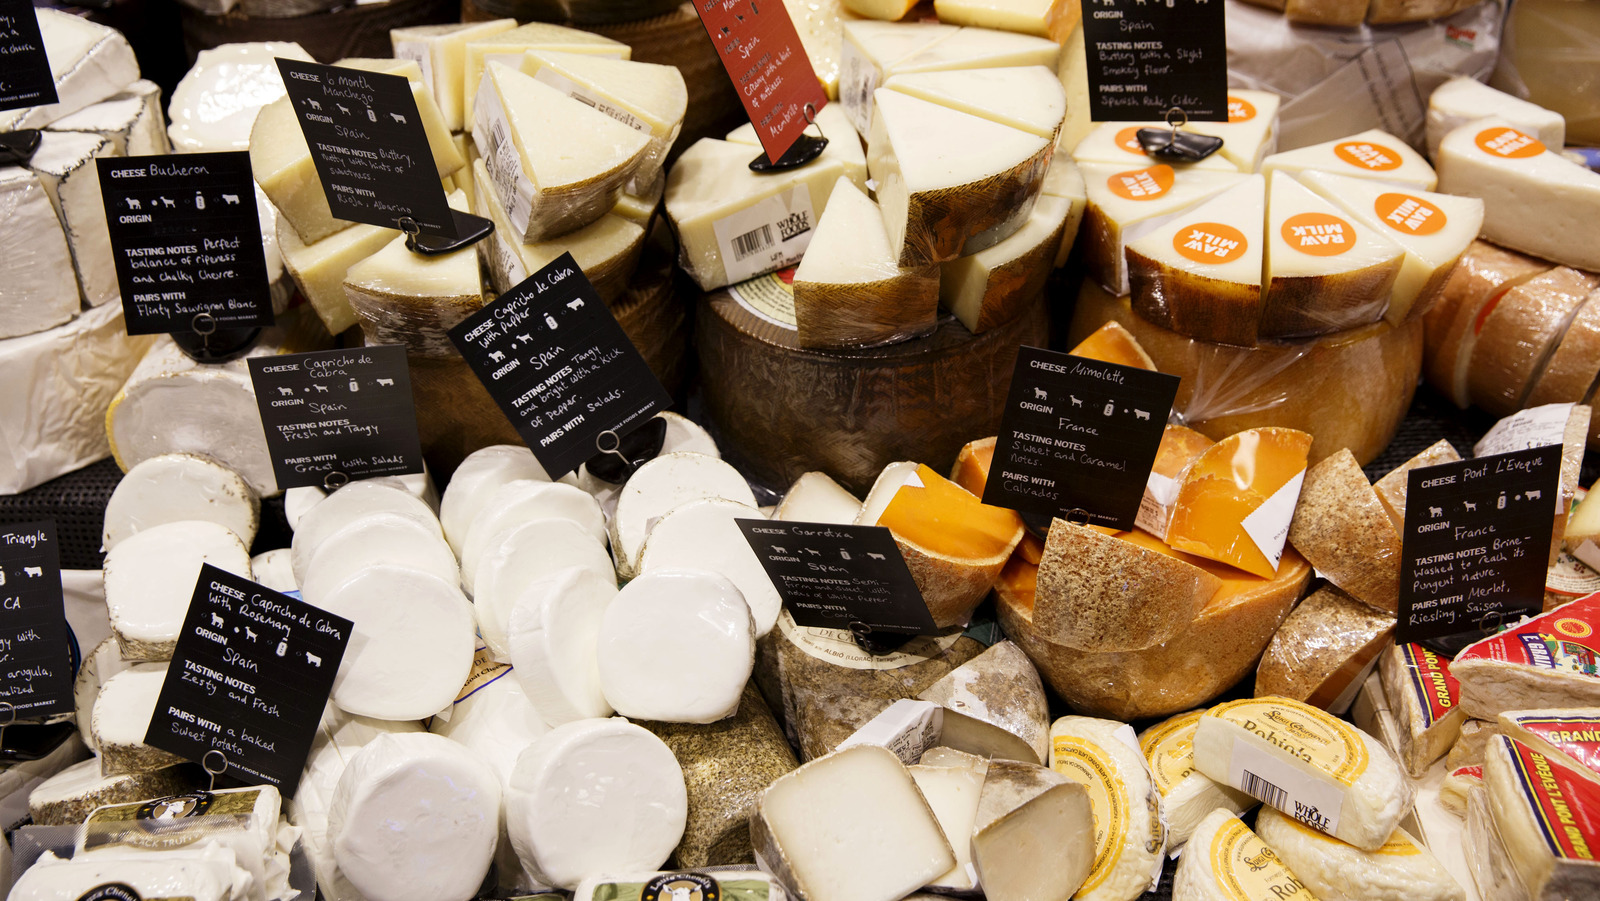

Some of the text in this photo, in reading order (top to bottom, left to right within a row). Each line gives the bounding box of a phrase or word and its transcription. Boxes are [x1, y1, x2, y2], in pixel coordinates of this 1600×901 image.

[1093, 11, 1123, 19] ORIGIN
[1120, 19, 1154, 32] Spain
[738, 37, 760, 58] Spain
[1096, 41, 1163, 50] TASTING NOTES
[290, 71, 334, 85] CHEESE 6
[744, 74, 765, 96] Creamy
[322, 85, 373, 104] Manchego
[305, 113, 333, 124] ORIGIN
[769, 103, 798, 137] Membrillo
[335, 125, 370, 140] Spain
[1484, 130, 1519, 150] RAW
[316, 142, 378, 159] TASTING NOTES
[1358, 144, 1393, 164] RAW
[1495, 136, 1536, 156] MILK
[1343, 145, 1383, 169] MILK
[111, 164, 209, 178] CHEESE Bucheron
[332, 184, 376, 198] PAIRS WITH
[1120, 176, 1146, 196] RAW
[1135, 171, 1162, 195] MILK
[119, 214, 152, 224] ORIGIN
[776, 210, 809, 230] WHOLE
[1386, 198, 1420, 225] MILK
[1404, 206, 1434, 231] RAW
[781, 222, 809, 239] FOODS
[1188, 229, 1239, 249] MILK
[1291, 223, 1344, 236] MILK
[125, 236, 240, 257] TASTING NOTES Perfect
[1183, 239, 1230, 258] RAW
[1299, 234, 1346, 247] RAW
[131, 254, 236, 269] balance of ripeness
[132, 272, 155, 283] and
[133, 292, 185, 302] PAIRS WITH
[464, 266, 574, 343] CHEESE Capricho de Cabra
[137, 299, 256, 319] Flinty Blanc
[263, 355, 373, 373] CHEESE Capricho de
[492, 344, 565, 380] ORIGIN Spain
[309, 369, 347, 379] Cabra
[511, 345, 602, 408] TASTING NOTES Tangy
[1030, 360, 1125, 385] CHEESE Mimolette
[520, 367, 590, 417] and bright with
[271, 398, 347, 415] ORIGIN Spain
[1020, 401, 1053, 414] ORIGIN
[277, 419, 350, 431] TASTING NOTES
[282, 423, 379, 442] Fresh and Tangy
[540, 414, 585, 447] PAIRS WITH
[1058, 417, 1099, 436] France
[1013, 430, 1086, 452] TASTING NOTES
[285, 456, 312, 465] PAIRS
[1012, 440, 1126, 472] Sweet and Caramel
[294, 463, 333, 473] Great
[1421, 456, 1543, 489] CHEESE Pont L'Eveque
[1002, 471, 1055, 488] PAIRS WITH
[1003, 480, 1059, 501] Calvados
[2, 530, 47, 549] Triangle
[752, 526, 853, 539] CHEESE Garrotxa
[1418, 521, 1496, 541] ORIGIN France
[1415, 547, 1487, 566] TASTING NOTES
[1461, 548, 1525, 570] to reach its
[807, 563, 849, 574] Spain
[1462, 569, 1500, 582] nature.
[780, 575, 819, 583] TASTING
[4, 596, 21, 610] CA
[1412, 580, 1510, 611] PAIRS WITH Merlot,
[209, 581, 341, 640] CHEESE Capricho de Cabra
[796, 602, 823, 610] PAIRS
[1466, 601, 1503, 613] Saison
[239, 604, 291, 637] Rosemary
[17, 628, 41, 642] with
[195, 626, 228, 646] ORIGIN
[222, 648, 259, 673] Spain
[474, 657, 487, 667] DE
[7, 667, 52, 682] arugula,
[184, 659, 256, 694] TASTING NOTES
[1422, 647, 1452, 708] GRAND PON
[34, 699, 56, 707] MARKET
[181, 671, 280, 718] Zesty and Fresh
[168, 706, 275, 753] PAIRS WITH a baked
[171, 722, 206, 742] Sweet
[259, 772, 281, 784] MARKET
[1294, 800, 1331, 828] WHOLE
[1550, 797, 1594, 860] GRAND PONT
